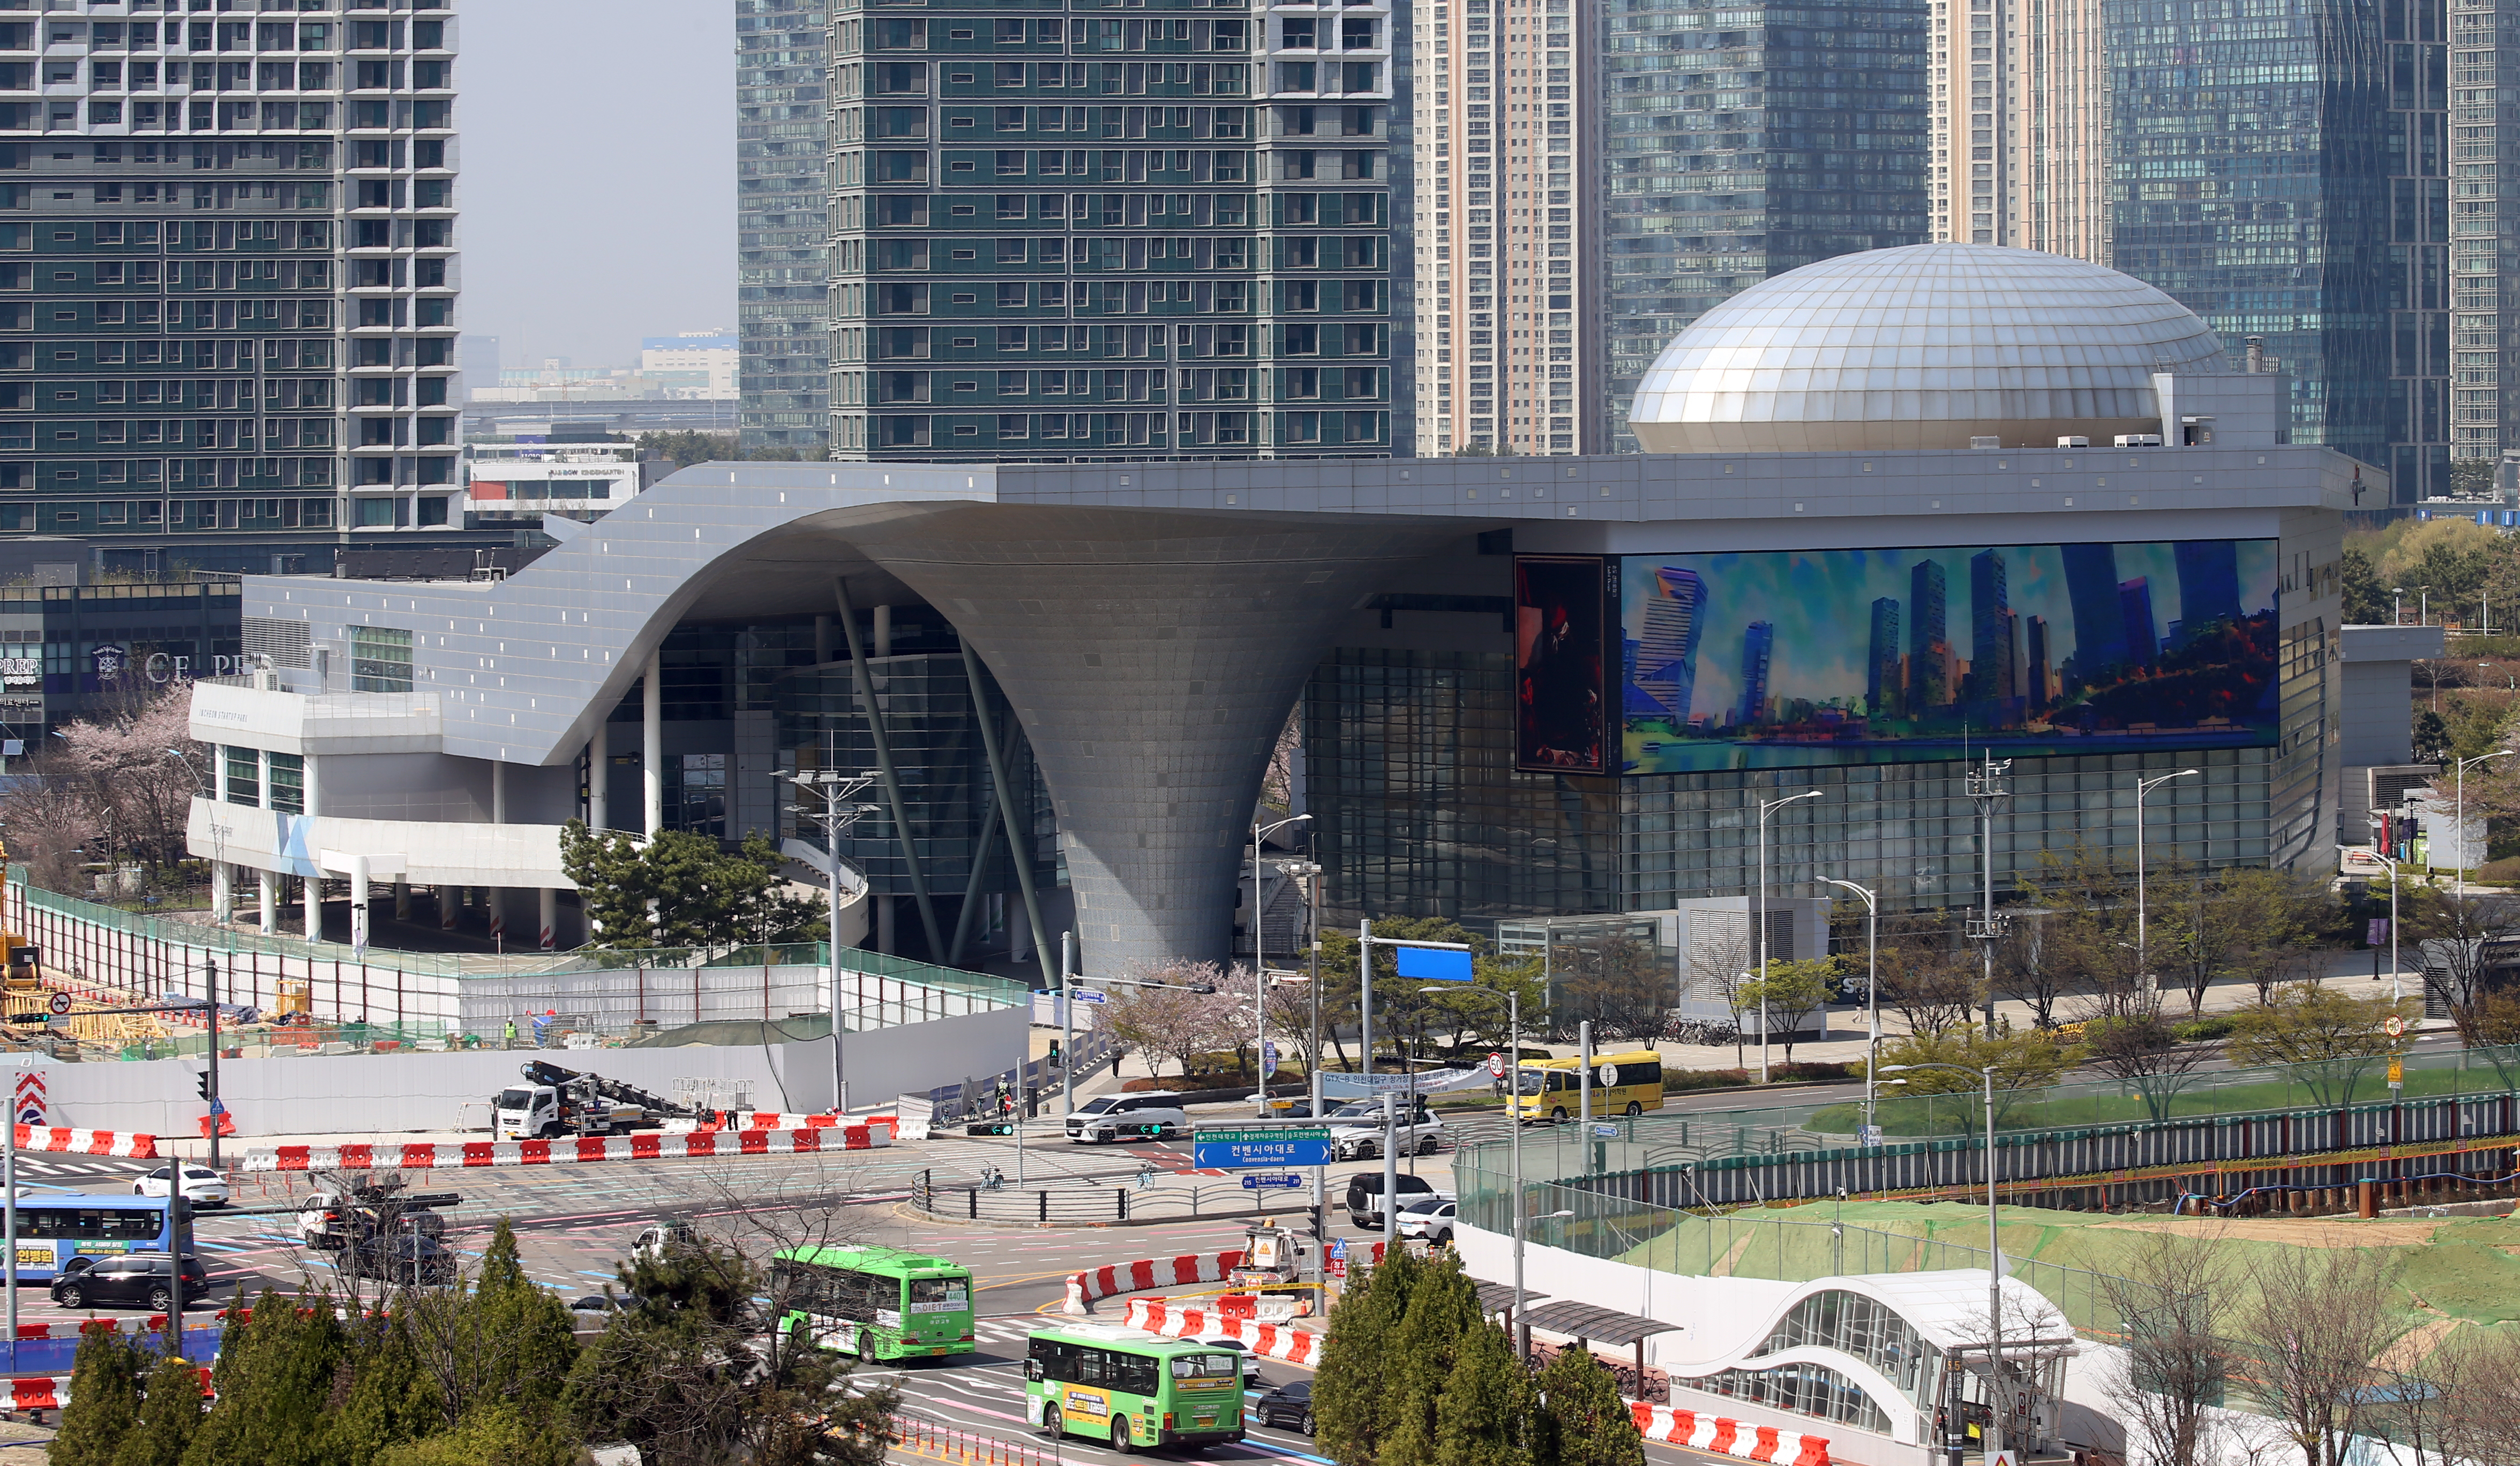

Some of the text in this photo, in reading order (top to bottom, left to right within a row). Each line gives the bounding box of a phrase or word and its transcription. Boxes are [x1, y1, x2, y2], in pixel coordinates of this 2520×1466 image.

[145, 652, 192, 683] CE
[4, 676, 36, 685] 영어유치부
[0, 698, 29, 706] 의료센터
[199, 708, 248, 723] INCHEON STARTUP PARK
[1491, 1059, 1502, 1071] 50
[1325, 1074, 1350, 1082] GTX-B
[1353, 1075, 1386, 1084] 인천대입구
[1602, 1088, 1626, 1097] 정상어학원
[1205, 1133, 1236, 1141] 인천대학교
[1249, 1132, 1284, 1140] 경제자유구역청
[1287, 1131, 1321, 1139] 송도컨벤시아
[1231, 1143, 1295, 1157] 컨벤시아대로
[16, 1250, 53, 1262] 인병원
[948, 1292, 964, 1300] 4401
[922, 1303, 942, 1312] DIET
[1209, 1359, 1230, 1368] 순환42
[1955, 1360, 1960, 1371] 5
